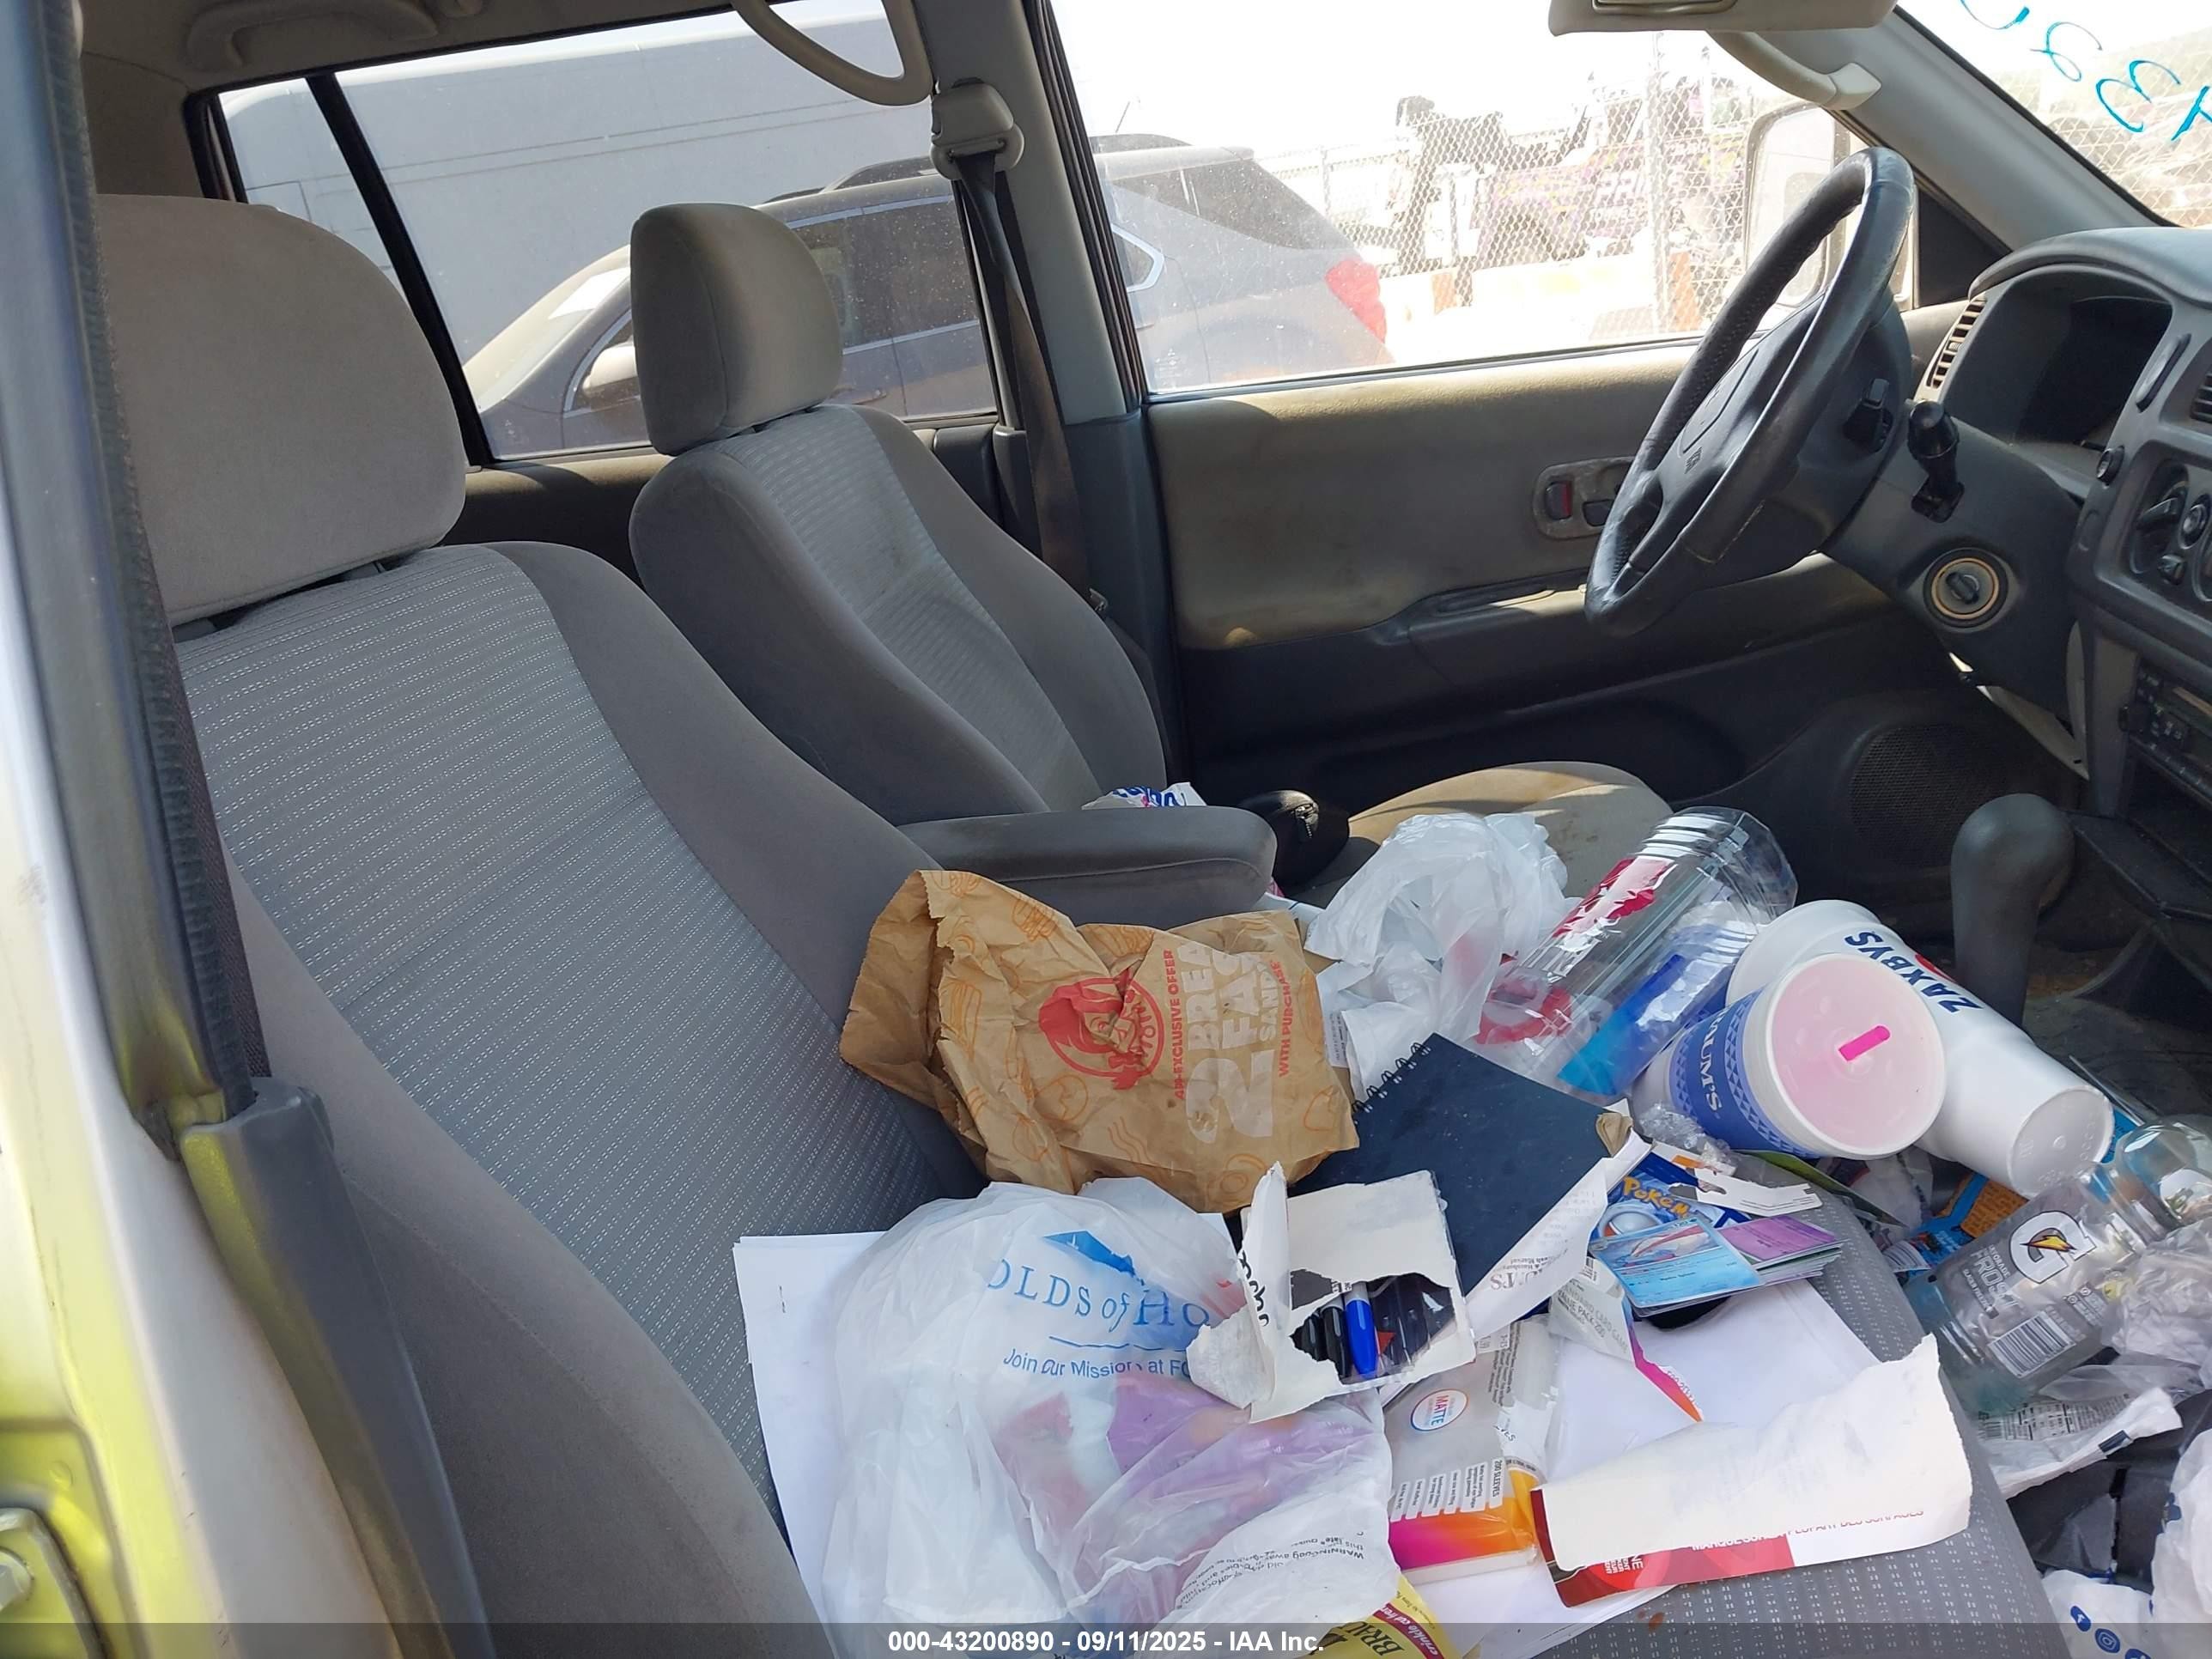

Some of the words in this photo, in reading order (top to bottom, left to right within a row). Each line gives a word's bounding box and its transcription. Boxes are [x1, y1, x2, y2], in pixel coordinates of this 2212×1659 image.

[1164, 950, 1179, 995] OFFER
[1844, 932, 1984, 1016] ZAXBYS
[1278, 1039, 1290, 1077] WITH
[1102, 1292, 1131, 1333] of
[1003, 1348, 1038, 1374] Join
[1040, 1359, 1066, 1376] Our
[1148, 1359, 1164, 1373] at
[1431, 1395, 1448, 1425] MATTE
[1396, 1614, 1411, 1626] cut
[1408, 1624, 1438, 1656] crinkle
